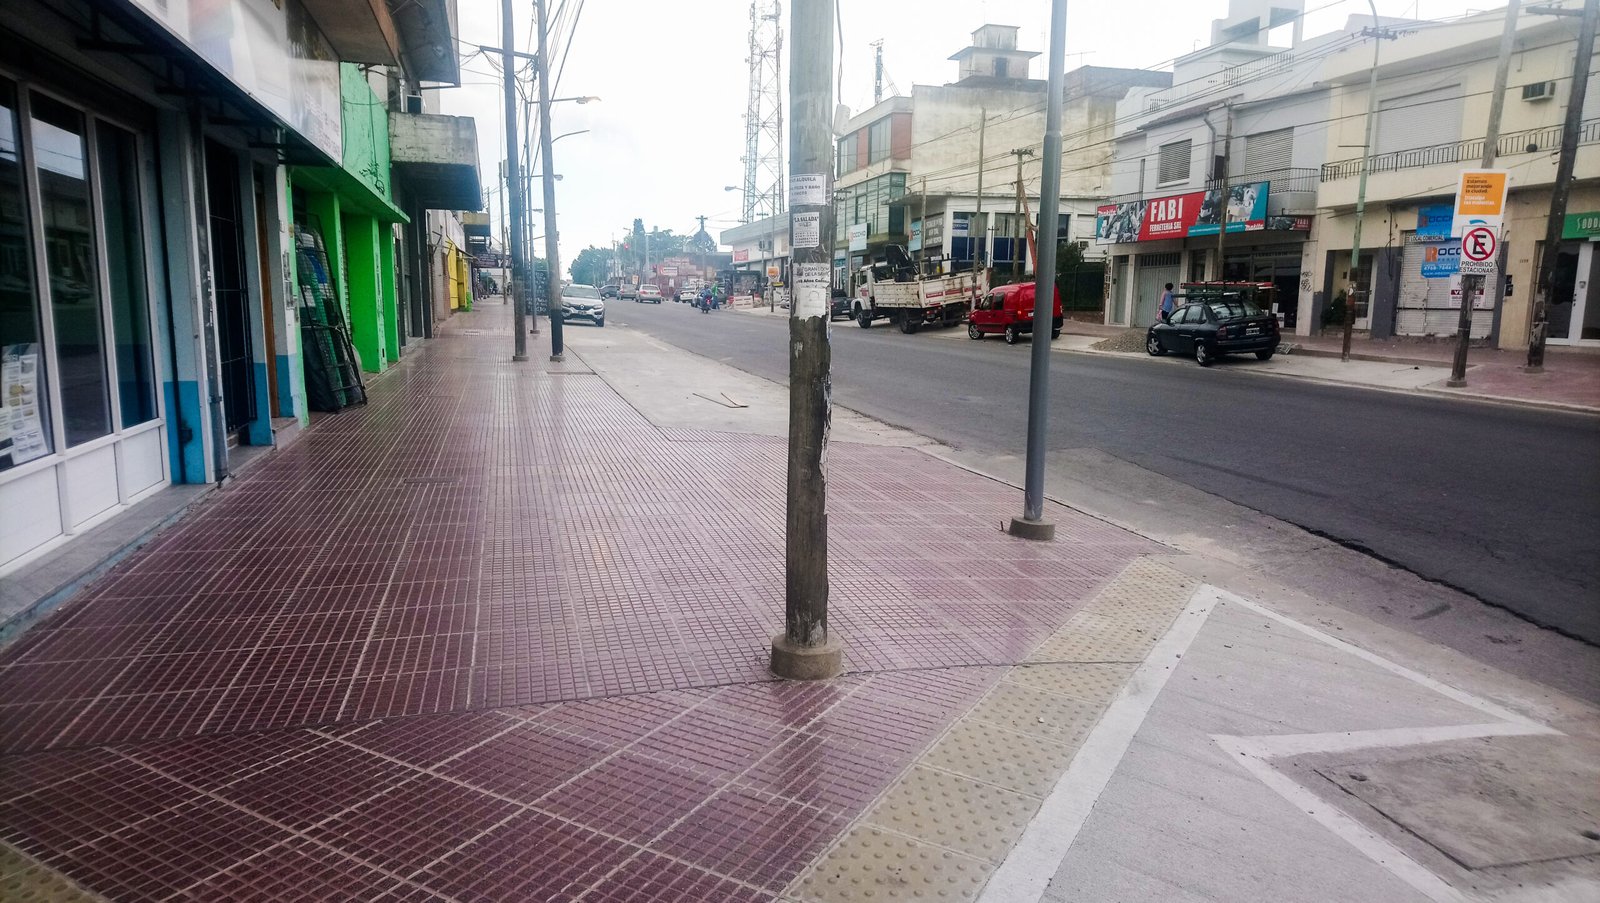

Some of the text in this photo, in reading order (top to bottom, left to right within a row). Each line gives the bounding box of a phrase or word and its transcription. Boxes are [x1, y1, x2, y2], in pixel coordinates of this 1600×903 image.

[1150, 197, 1184, 222] FABI
[1472, 234, 1487, 255] E
[1461, 260, 1493, 268] PROHIBIDO
